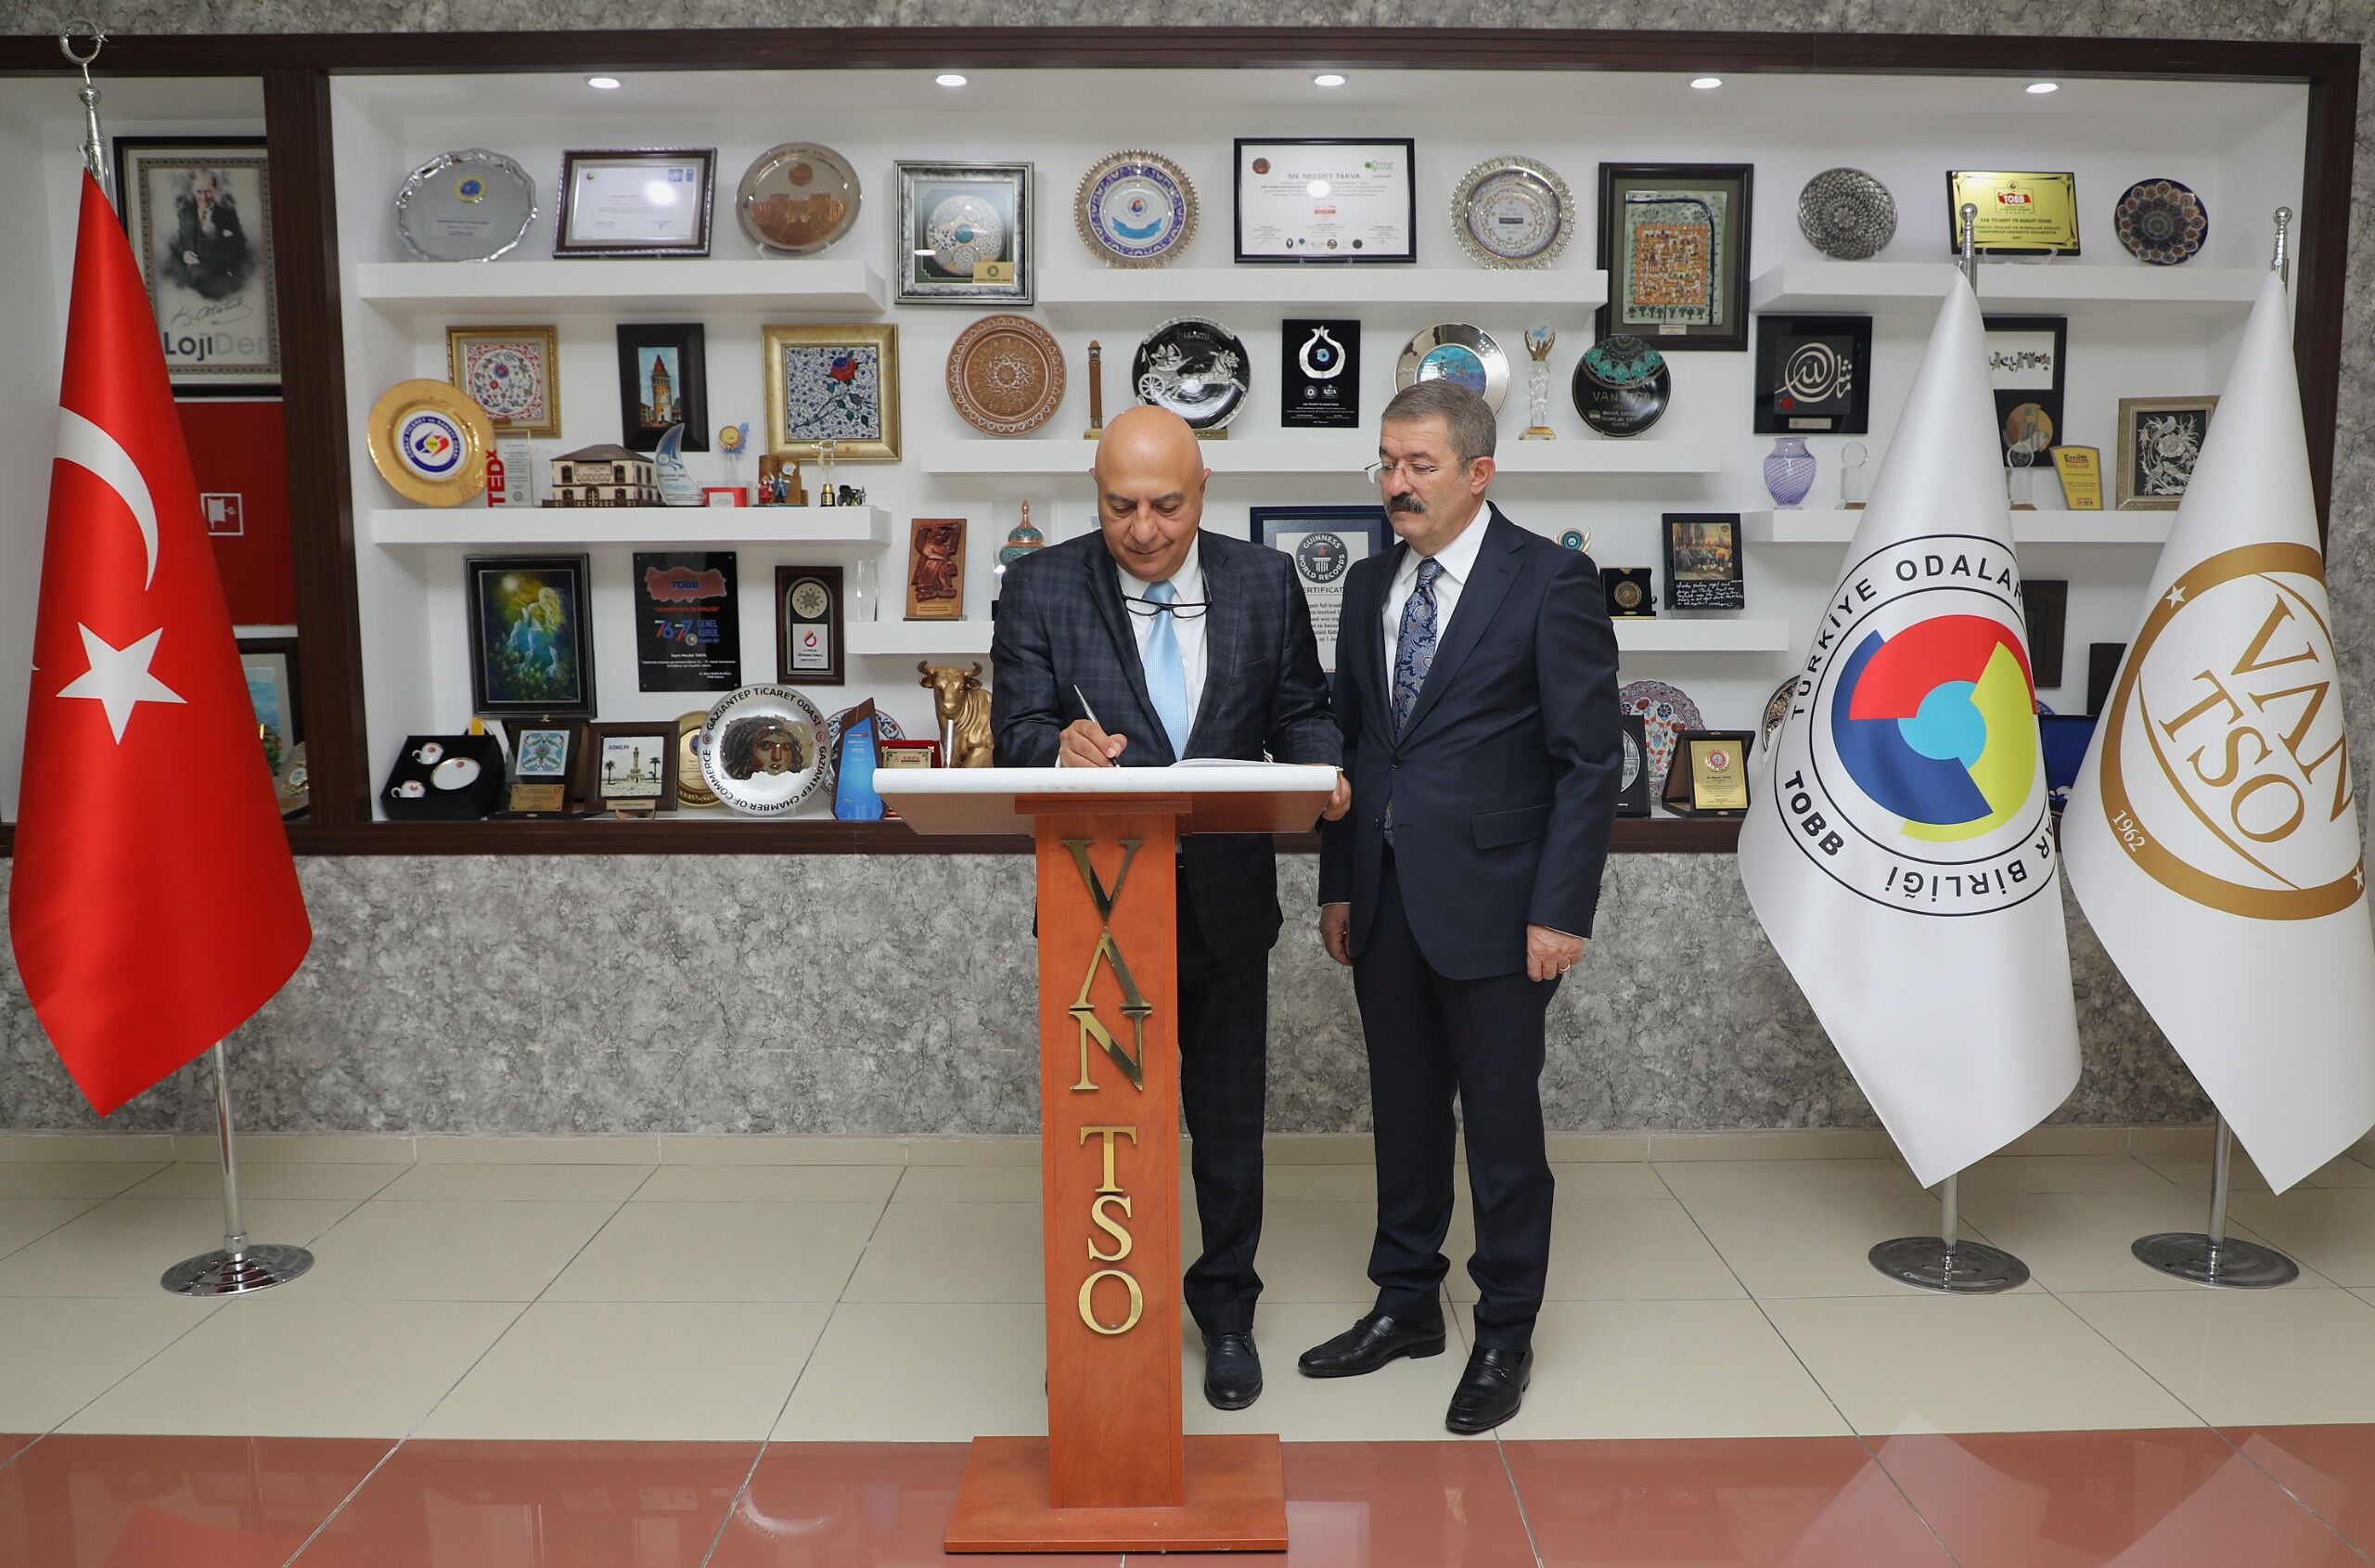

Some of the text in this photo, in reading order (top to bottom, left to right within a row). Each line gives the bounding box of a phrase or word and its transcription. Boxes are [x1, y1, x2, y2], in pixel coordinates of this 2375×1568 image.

[2003, 195, 2025, 204] TOBB
[1592, 391, 1619, 402] VAN
[1303, 534, 1342, 549] GUINNESS
[671, 580, 699, 589] TOBB
[1299, 554, 1345, 580] WORLD RECORDS
[1791, 577, 1877, 720] TÜRKİYE
[2230, 594, 2354, 822] VAN
[702, 750, 734, 800] COMMERCE
[2158, 669, 2304, 843] TSO
[733, 798, 748, 808] OF
[749, 795, 800, 812] CHAMBER
[1785, 770, 1844, 855] TOBB
[2112, 810, 2146, 852] 1962
[1885, 859, 2028, 902] BİRLİĞİ
[1061, 839, 1152, 1091] VAN
[1078, 1125, 1144, 1335] TSO
